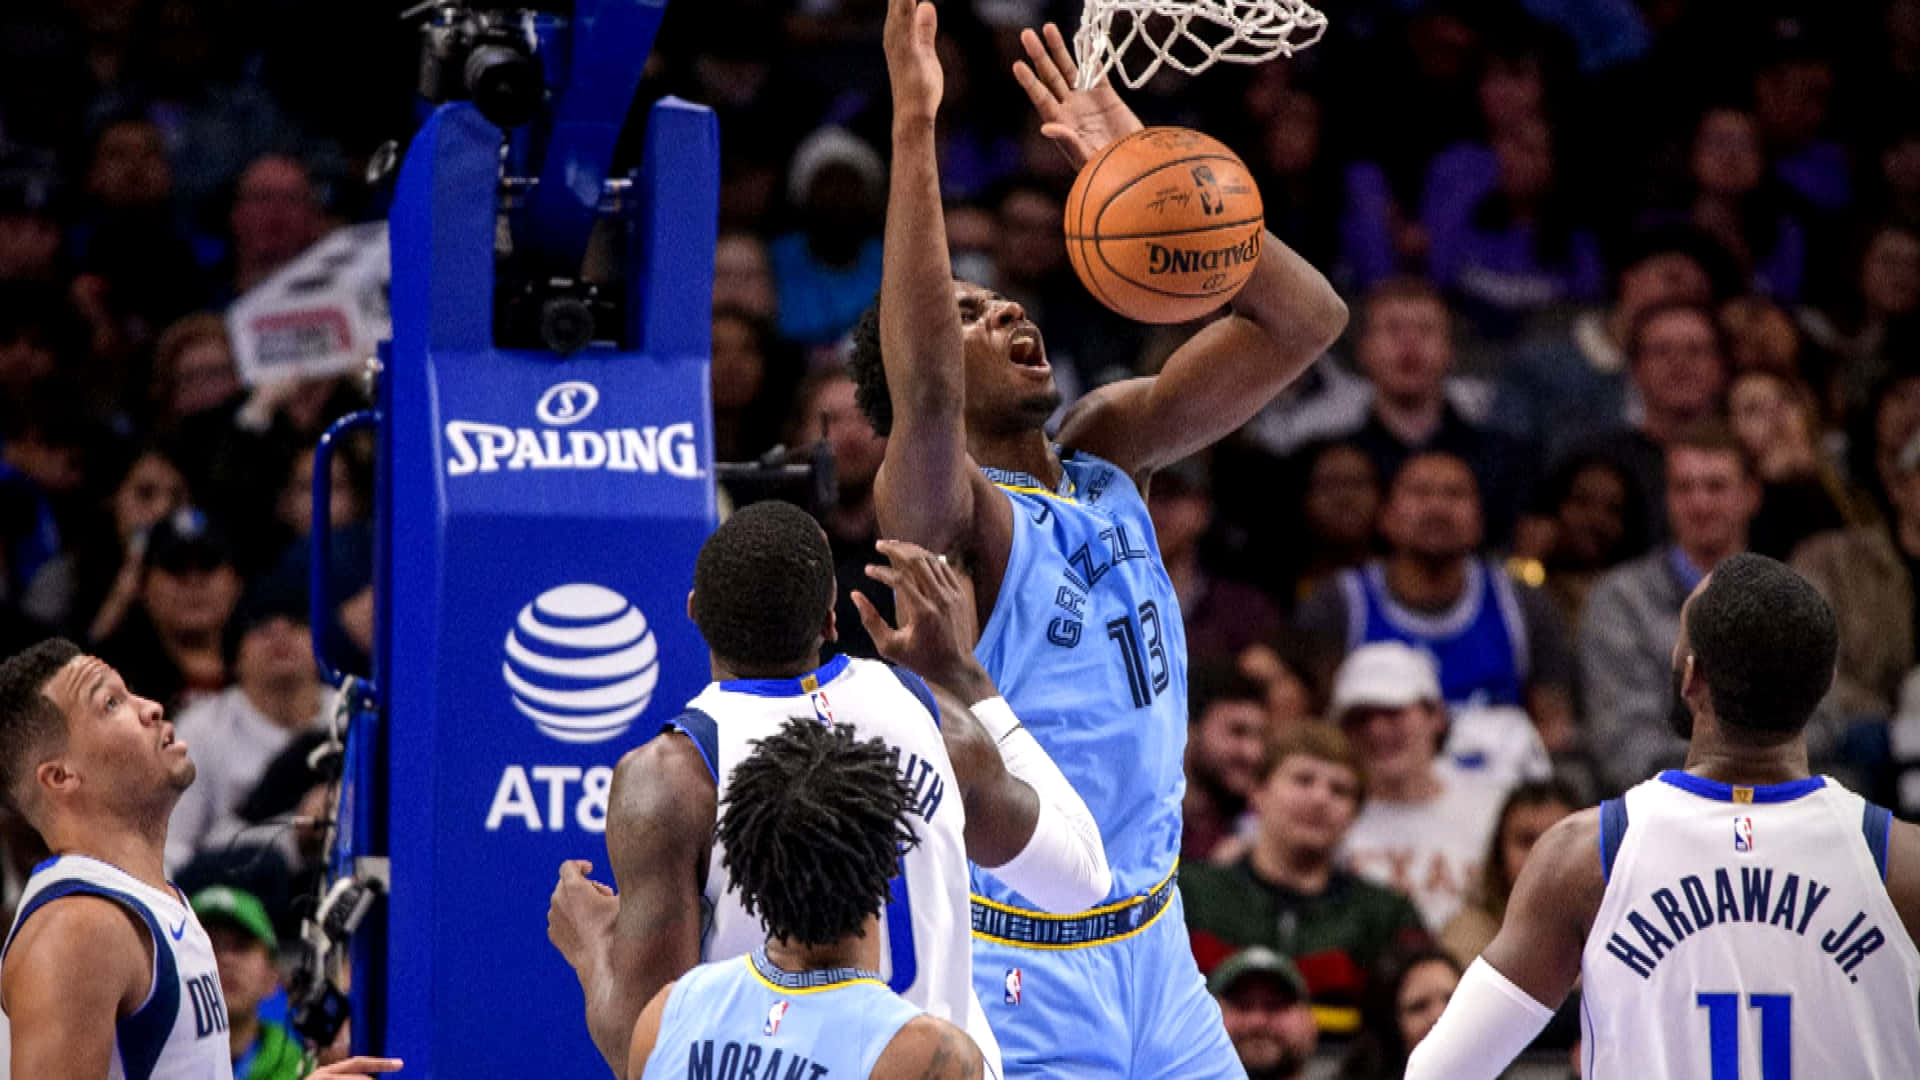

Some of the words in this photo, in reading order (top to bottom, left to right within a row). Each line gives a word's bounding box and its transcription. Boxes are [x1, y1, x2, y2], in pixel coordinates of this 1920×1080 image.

[446, 420, 699, 479] SPALDING
[1106, 599, 1170, 709] 13
[892, 745, 944, 824] ITH
[1606, 866, 1831, 980] HARDAWAY
[1820, 911, 1886, 985] JR.
[1696, 991, 1793, 1080] 11
